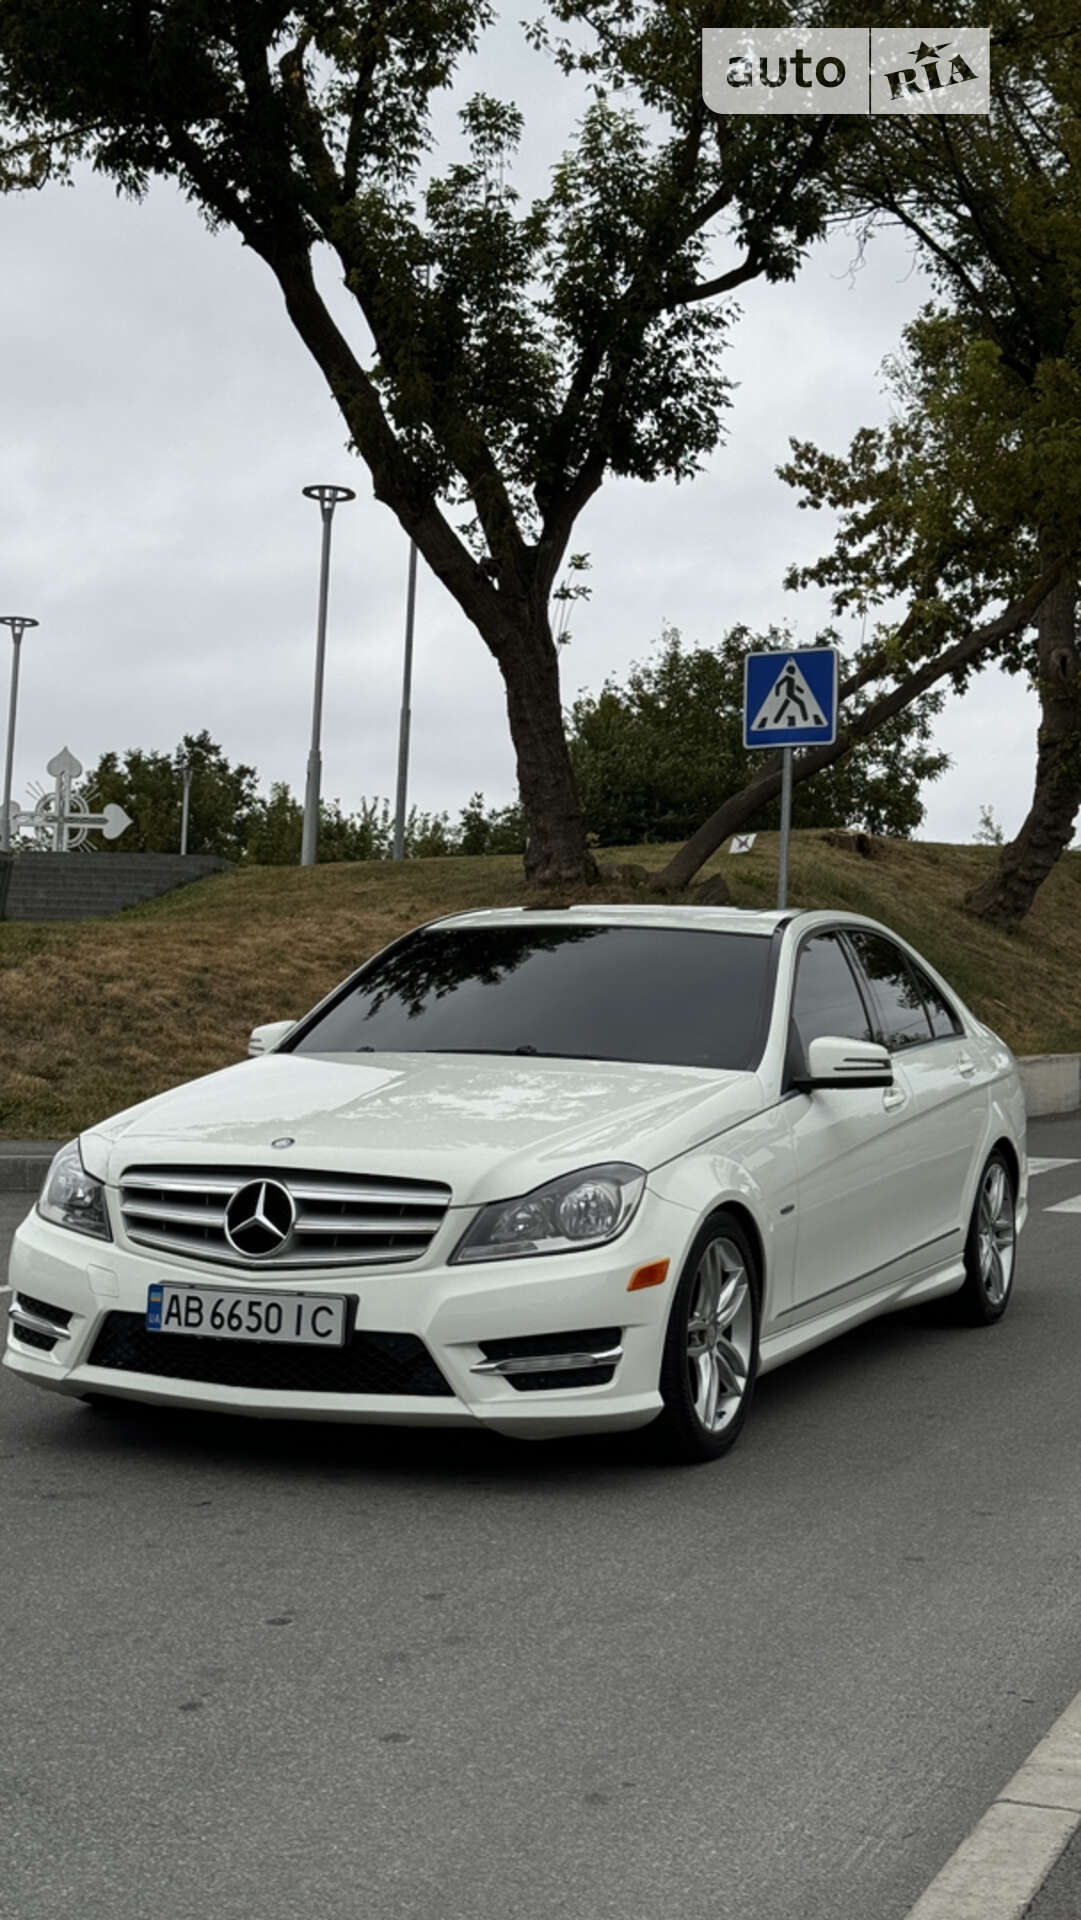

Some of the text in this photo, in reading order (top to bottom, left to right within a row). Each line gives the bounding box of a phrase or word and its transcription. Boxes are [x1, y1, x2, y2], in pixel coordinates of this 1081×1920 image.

[164, 1294, 334, 1338] AB 6650 IC
